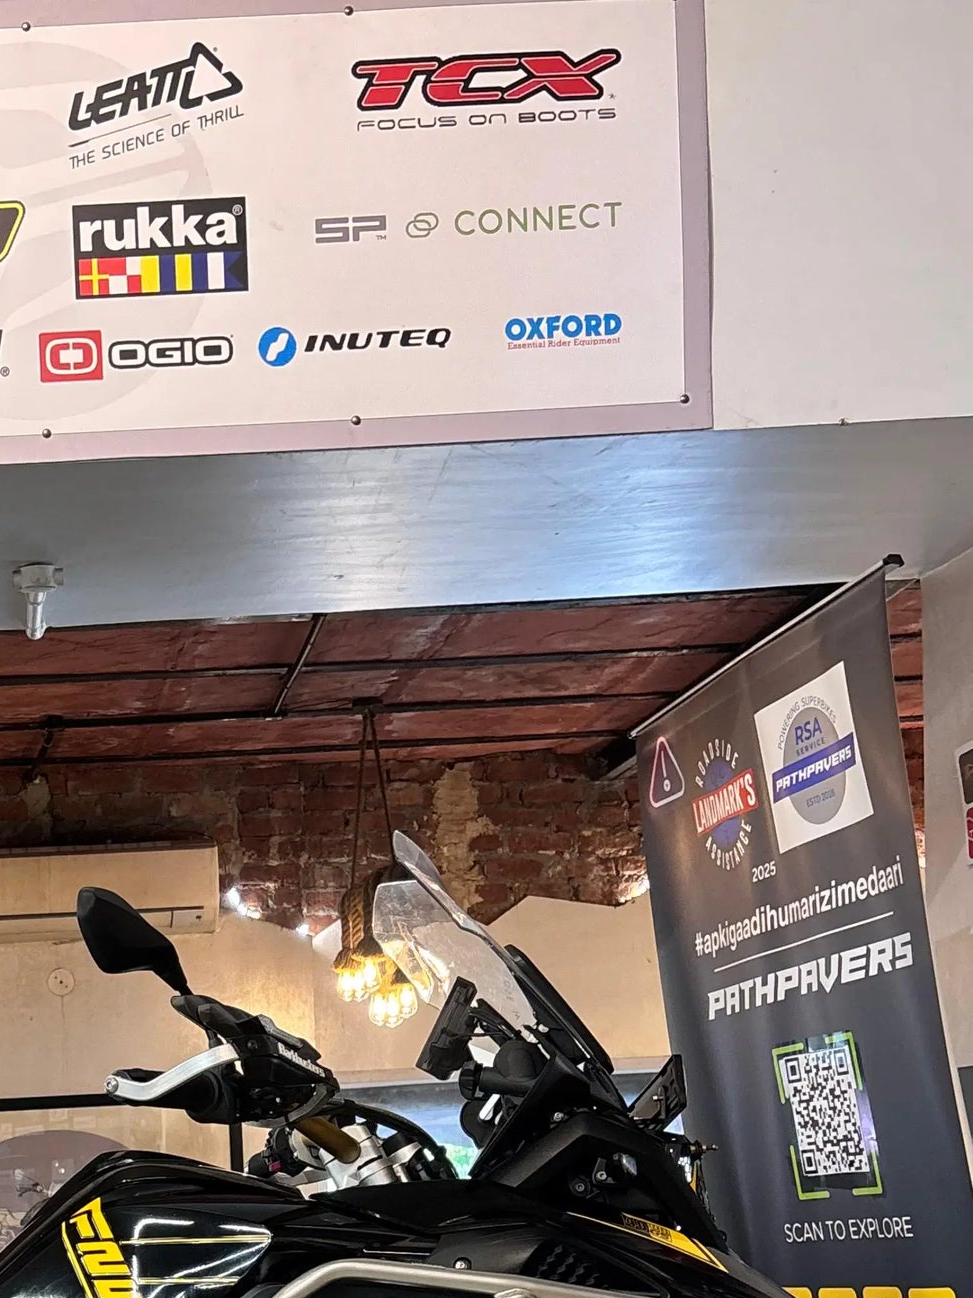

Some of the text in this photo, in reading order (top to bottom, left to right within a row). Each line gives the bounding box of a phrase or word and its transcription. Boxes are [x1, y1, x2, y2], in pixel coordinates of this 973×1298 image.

[351, 48, 623, 111] TCX
[68, 106, 245, 170] THE SCIENCE OF THRILL
[357, 107, 617, 132] FOCUS ON BOOTS
[79, 206, 237, 252] rukka
[315, 201, 623, 243] SP CONNECT
[304, 327, 452, 353] INUTEQ
[504, 312, 623, 342] OXFORD
[507, 336, 621, 350] Essential Rider Equipment
[108, 335, 233, 368] OGIO
[778, 702, 801, 750] POWERING
[794, 717, 823, 746] RSA
[796, 737, 825, 757] SERVICE
[695, 738, 739, 788] ROADSIDE
[776, 745, 851, 793] PATHPAVERS
[692, 773, 756, 833] LANDMARK'S
[705, 819, 752, 871] ASSISTANCE
[752, 860, 777, 882] 2025
[695, 855, 904, 957] #apkigaadihumarizimedaari
[707, 932, 914, 1021] PATHPAVERS
[784, 1216, 914, 1244] SCAN TO EXPLORE
